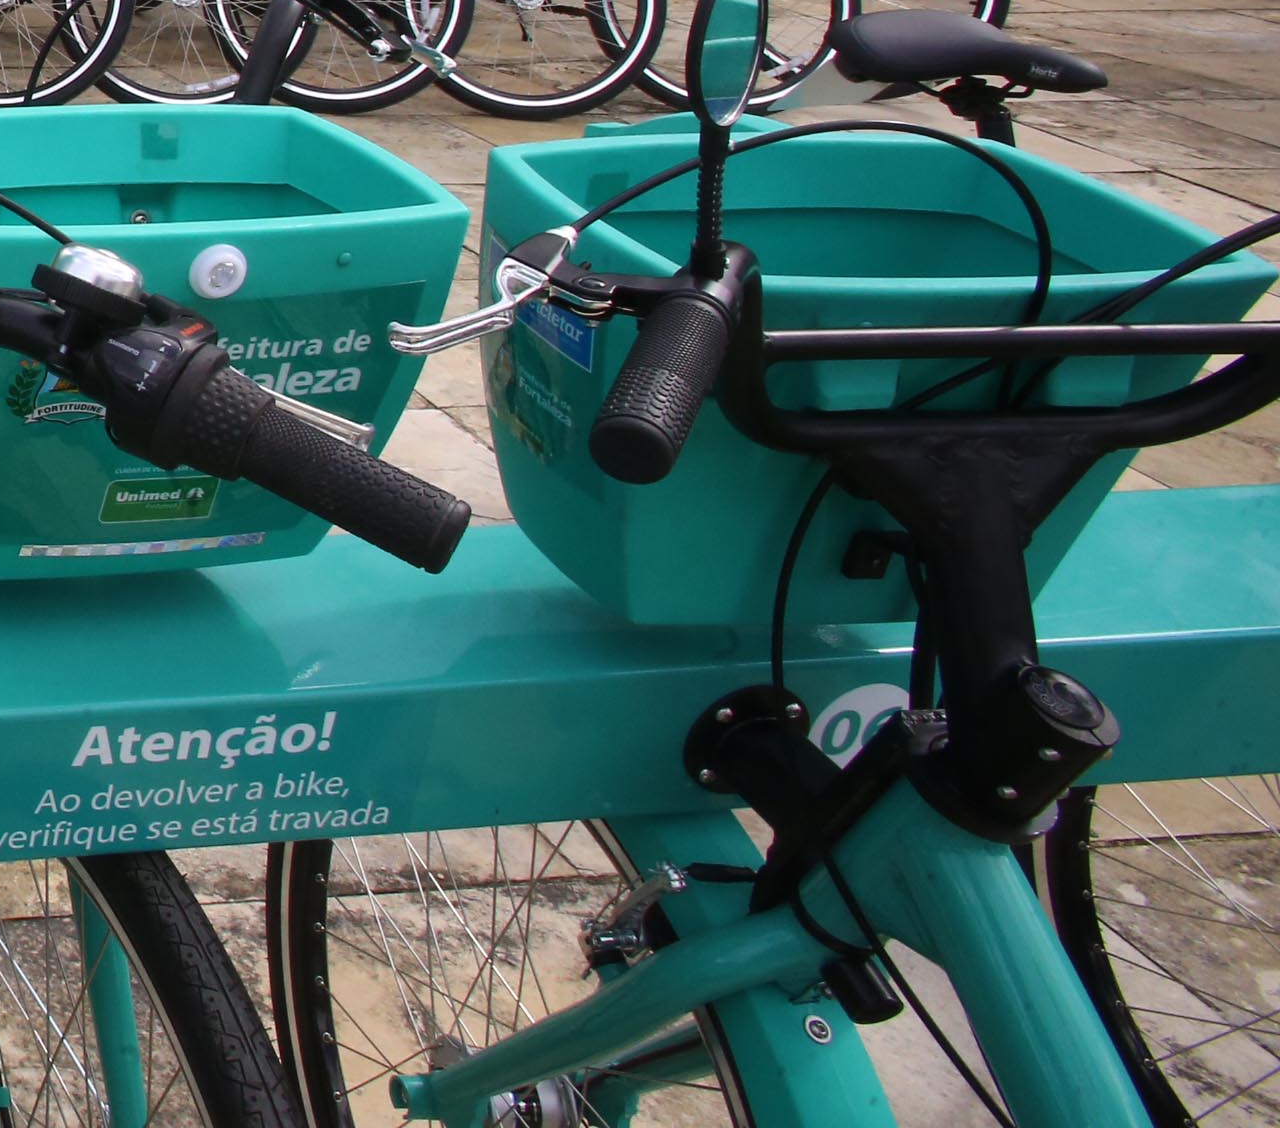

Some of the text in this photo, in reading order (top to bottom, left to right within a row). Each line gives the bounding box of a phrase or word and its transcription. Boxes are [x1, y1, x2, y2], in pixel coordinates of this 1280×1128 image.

[217, 329, 371, 361] feitura de
[252, 362, 361, 396] aleza
[38, 403, 104, 418] FORTITUDINE
[115, 487, 182, 503] Unimed
[71, 711, 337, 769] Atenção!
[34, 772, 350, 815] Ao devolver a bike,
[147, 817, 181, 840] se
[191, 808, 257, 837] está
[269, 801, 390, 833] travada
